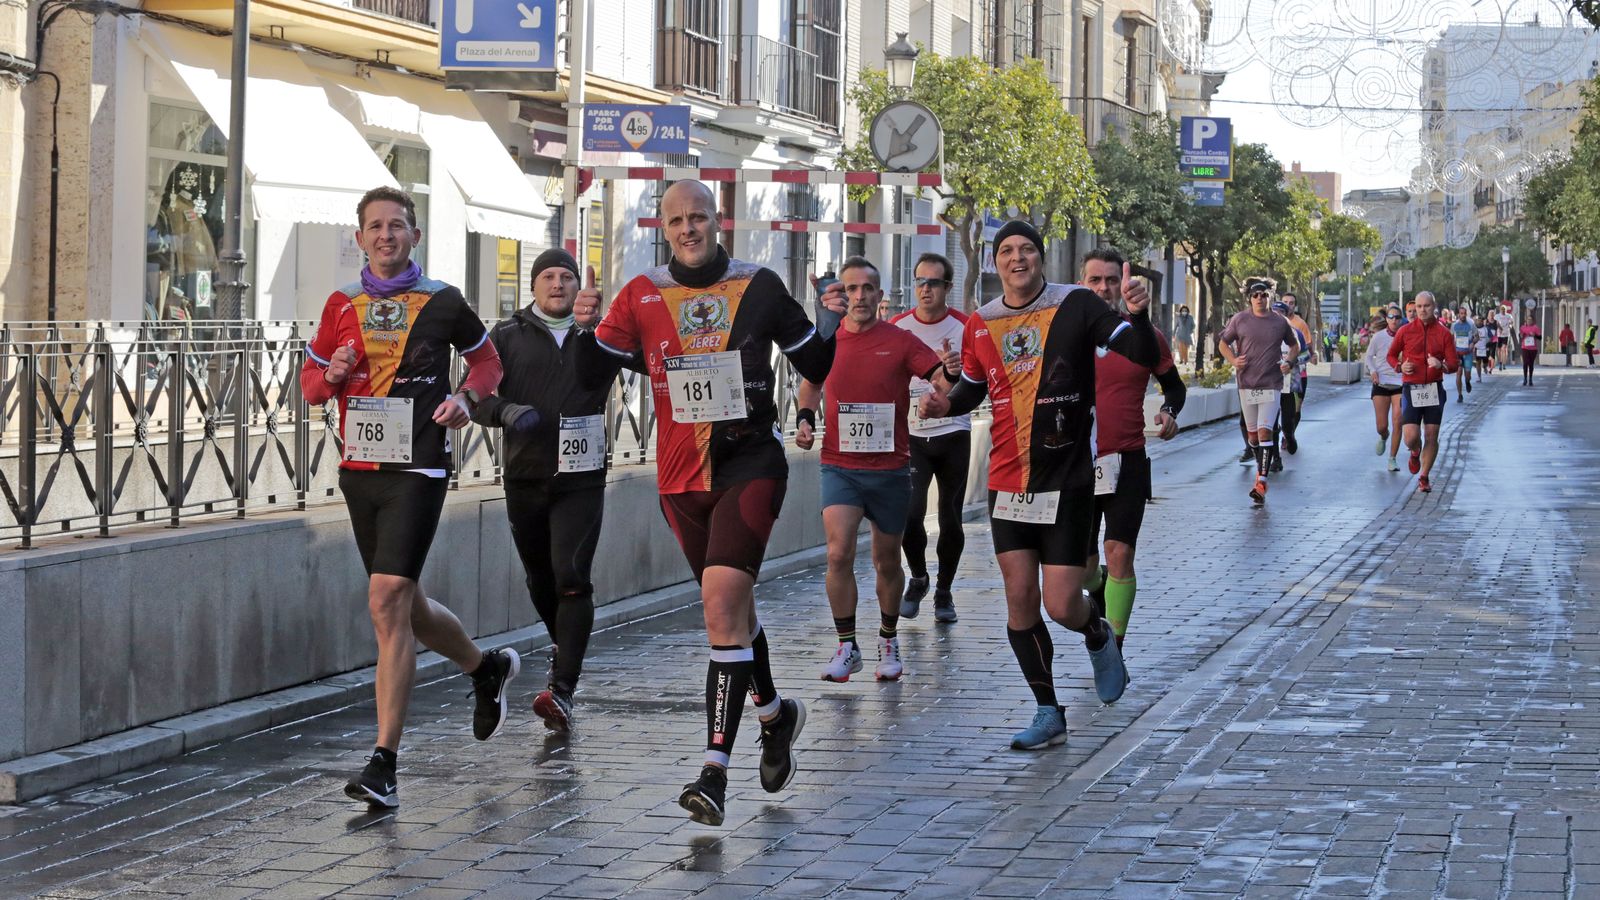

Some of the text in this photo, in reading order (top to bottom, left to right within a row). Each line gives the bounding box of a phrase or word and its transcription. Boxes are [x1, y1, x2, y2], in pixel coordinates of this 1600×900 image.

[459, 47, 536, 57] Plaza del Arenal
[1192, 118, 1218, 149] P
[1192, 166, 1215, 176] LIBRE
[689, 335, 721, 350] JEREZ
[687, 368, 719, 378] ALBERTO
[1010, 359, 1037, 374] JEREZ
[682, 380, 713, 401] 181
[356, 422, 385, 442] 768
[849, 422, 874, 438] 370
[562, 438, 588, 456] 290
